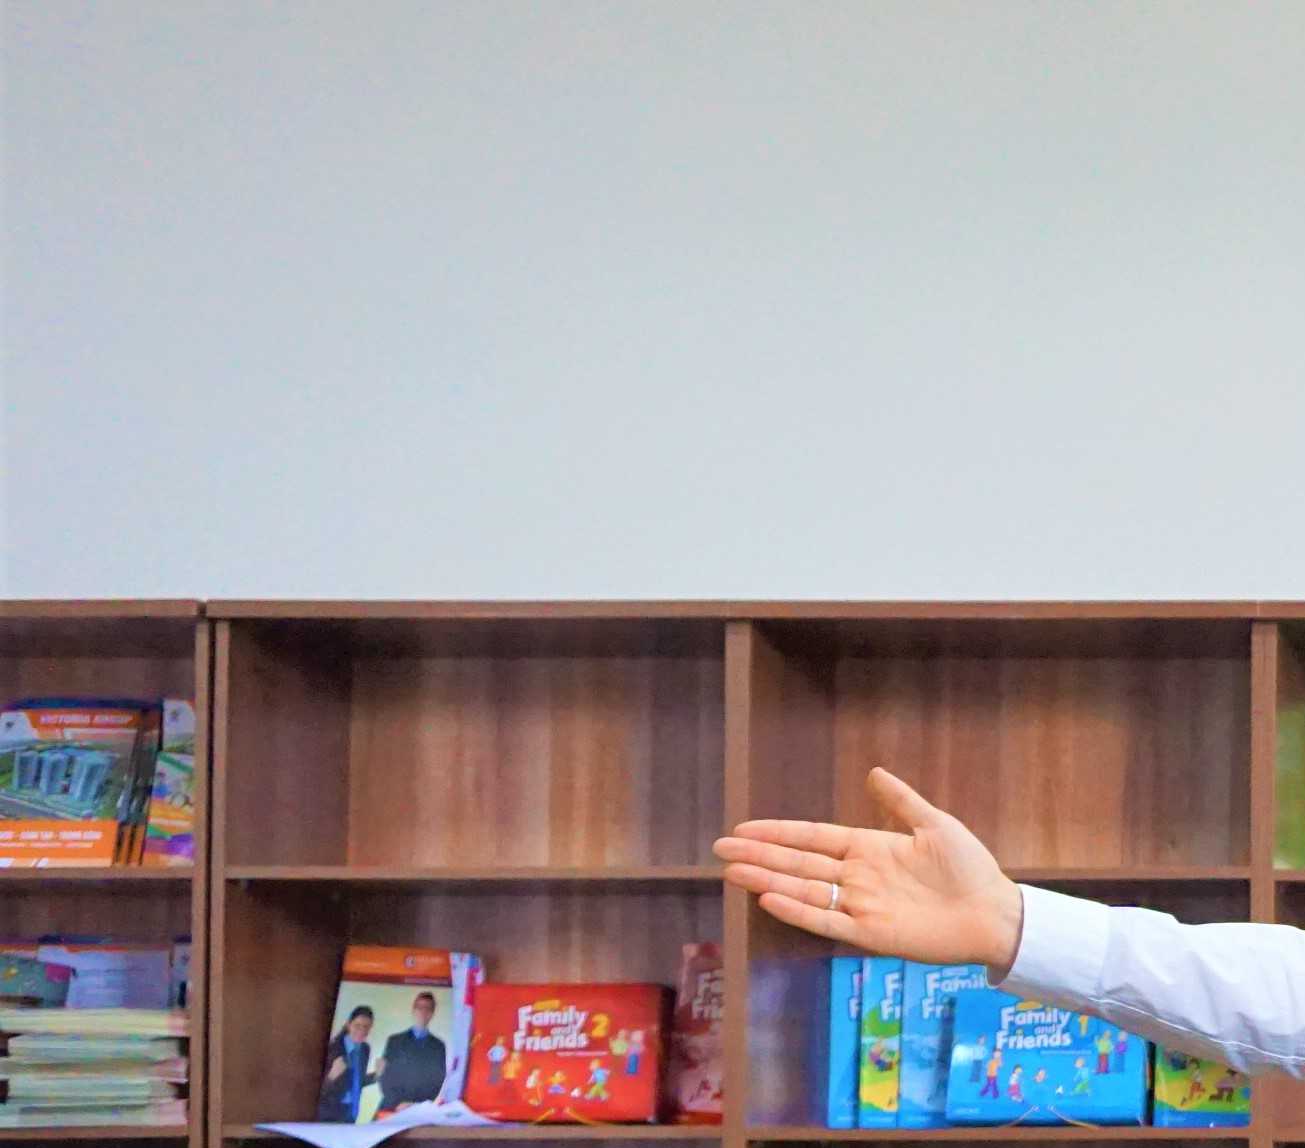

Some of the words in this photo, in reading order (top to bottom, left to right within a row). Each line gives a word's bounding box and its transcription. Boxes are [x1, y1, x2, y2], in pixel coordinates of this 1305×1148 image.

[925, 972, 985, 998] Famil
[518, 1005, 588, 1033] Family
[592, 1013, 609, 1038] 2
[1001, 1007, 1071, 1032] Family
[1034, 1023, 1056, 1035] and
[514, 1028, 588, 1052] Friends
[996, 1029, 1072, 1050] Friends
